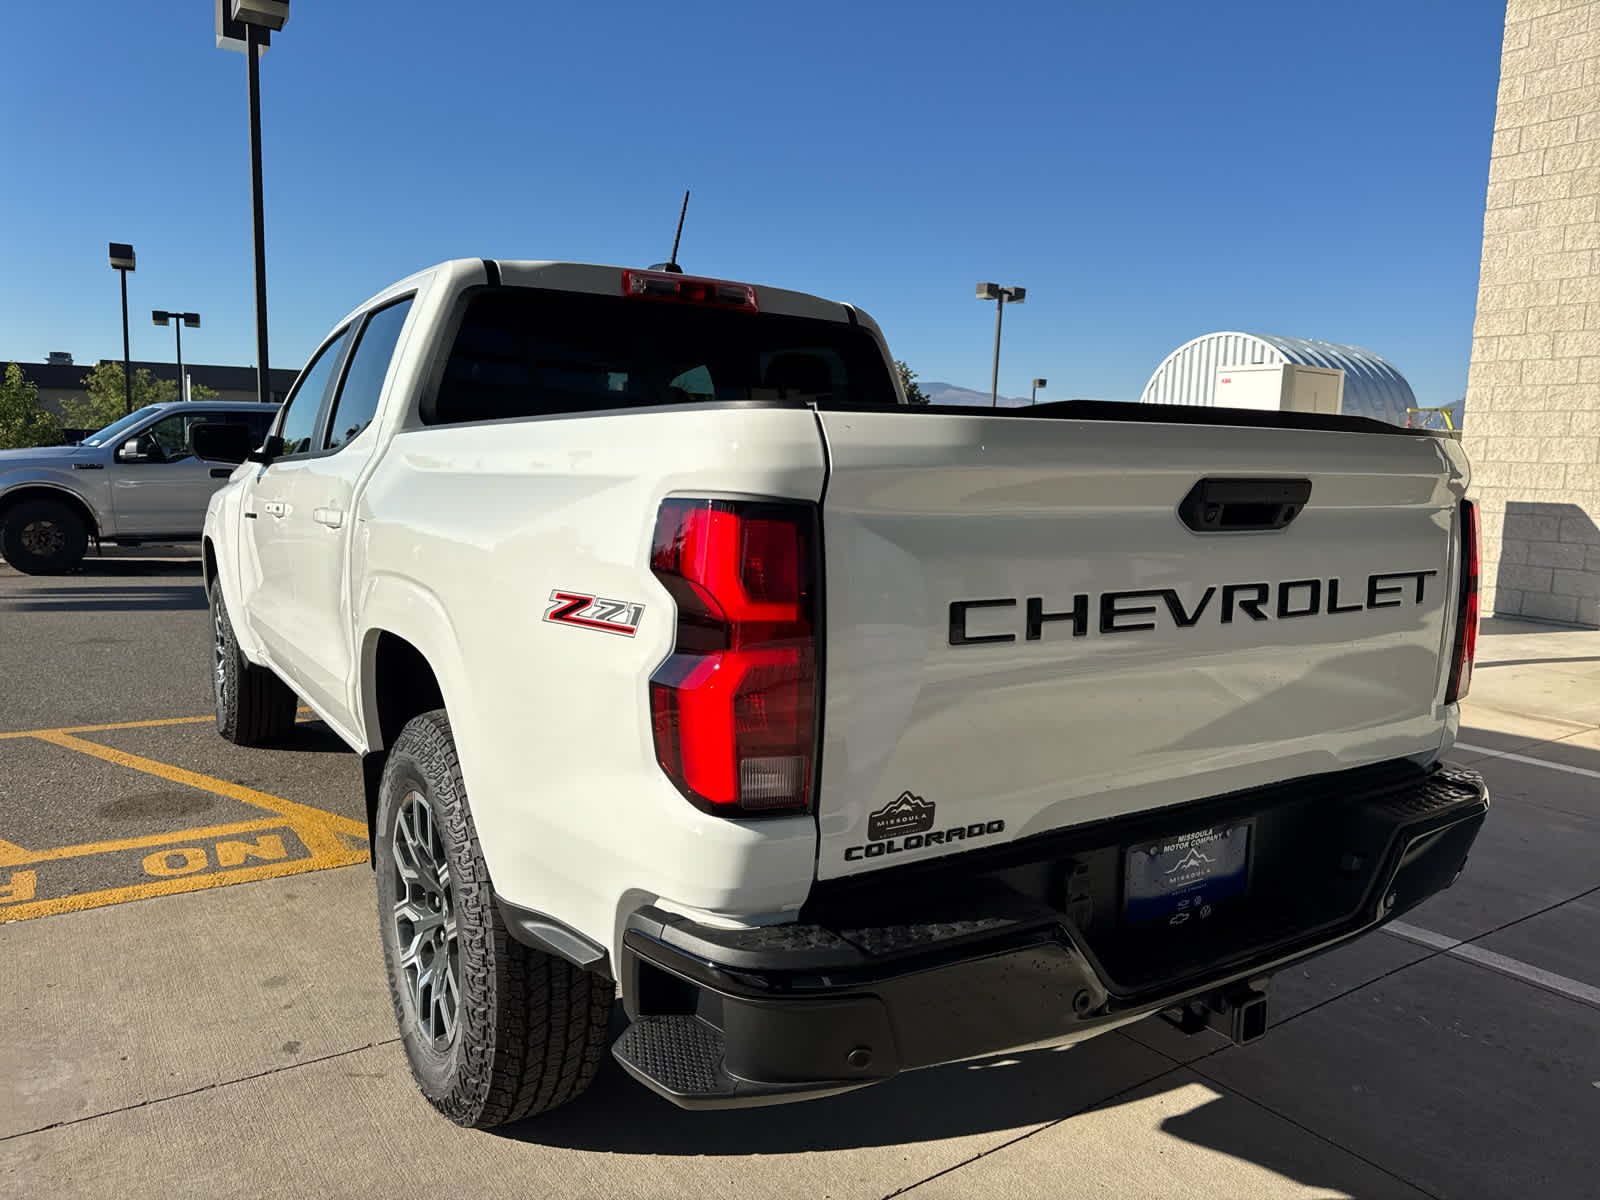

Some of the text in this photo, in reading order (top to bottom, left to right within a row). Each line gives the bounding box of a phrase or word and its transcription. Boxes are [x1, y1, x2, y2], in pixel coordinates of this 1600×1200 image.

[542, 588, 646, 638] Z71
[949, 569, 1438, 646] CHEVROLET
[876, 813, 927, 828] MISSOULA
[1177, 828, 1214, 843] MISSOULA
[142, 834, 288, 877] NO
[844, 819, 1006, 862] COLORADO
[1163, 832, 1223, 854] MOTOR COMPANY
[1169, 869, 1211, 883] MISSOULA
